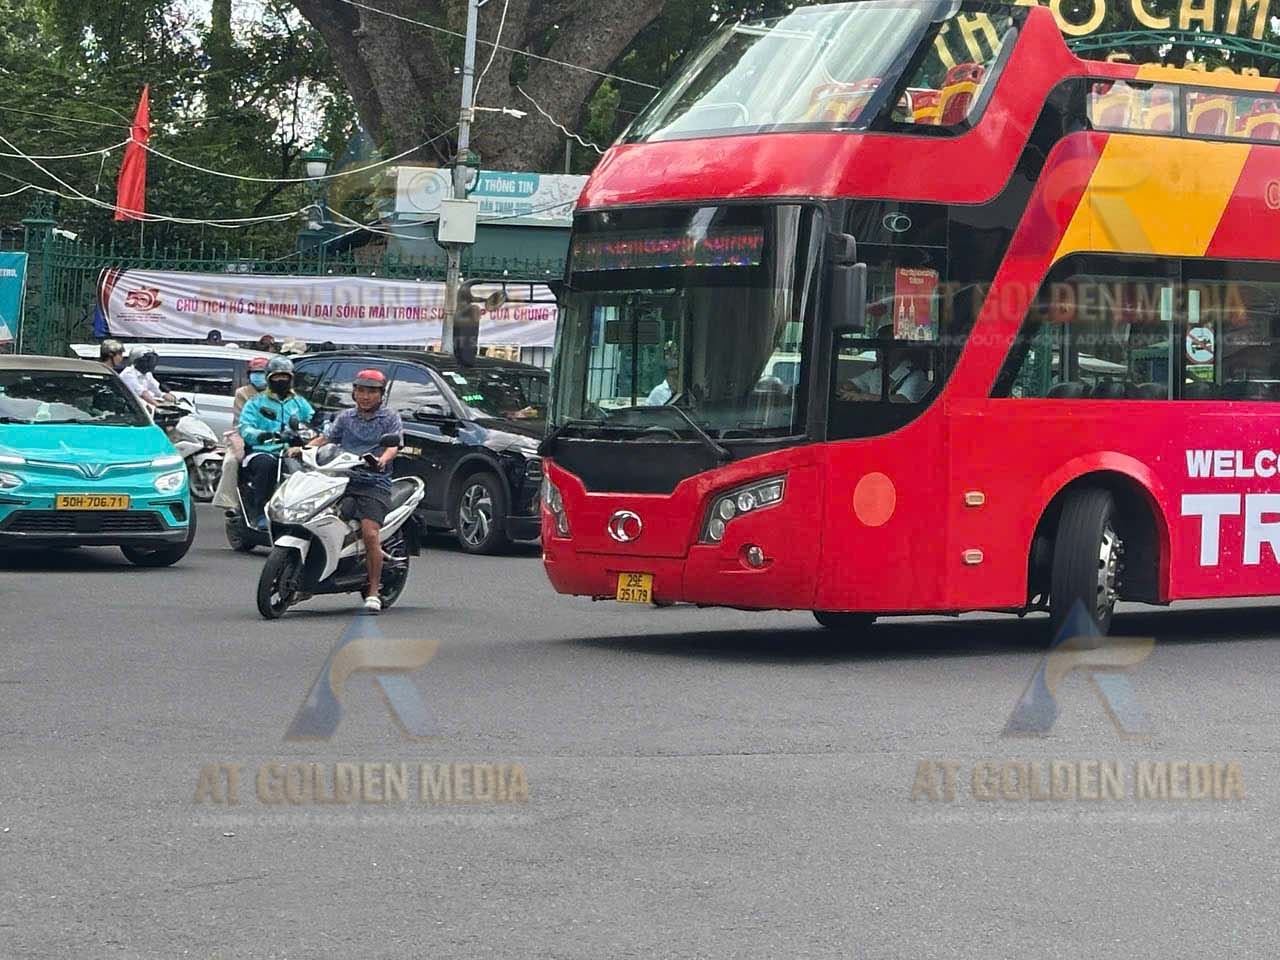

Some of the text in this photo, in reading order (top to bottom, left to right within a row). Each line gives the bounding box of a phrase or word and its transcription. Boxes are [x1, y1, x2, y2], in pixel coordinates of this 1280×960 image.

[518, 180, 534, 193] TIN
[269, 303, 298, 317] MINH
[393, 306, 428, 320] TRONG
[627, 574, 643, 588] 29E
